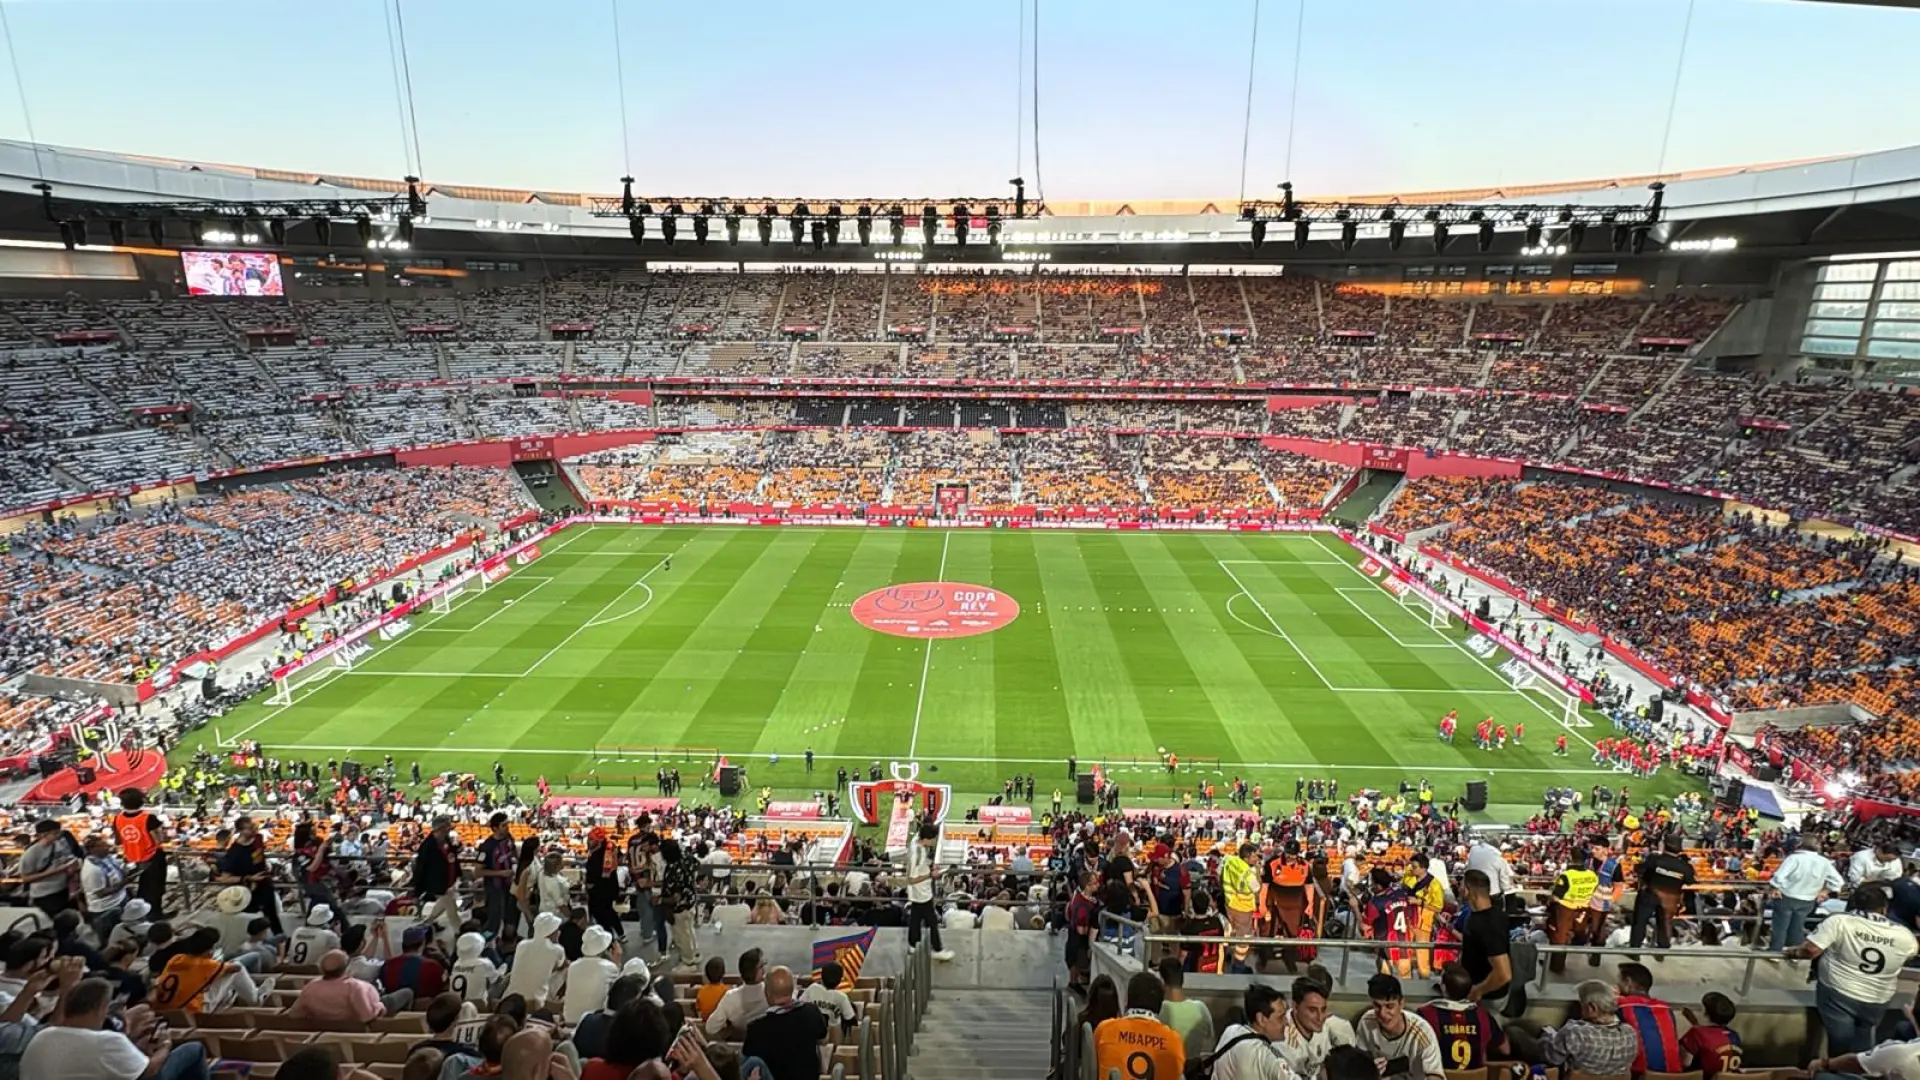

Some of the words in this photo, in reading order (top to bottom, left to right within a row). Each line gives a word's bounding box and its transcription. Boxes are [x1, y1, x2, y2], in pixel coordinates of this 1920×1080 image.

[953, 591, 996, 602] COPA
[960, 601, 988, 611] REY
[1393, 911, 1407, 933] 4
[1854, 931, 1895, 948] MBAPPE
[293, 941, 308, 964] 9
[1859, 947, 1886, 975] 9
[156, 974, 179, 1004] 9
[452, 974, 468, 1001] 9
[1118, 1031, 1167, 1051] MBAPPE
[1451, 1039, 1471, 1071] 9
